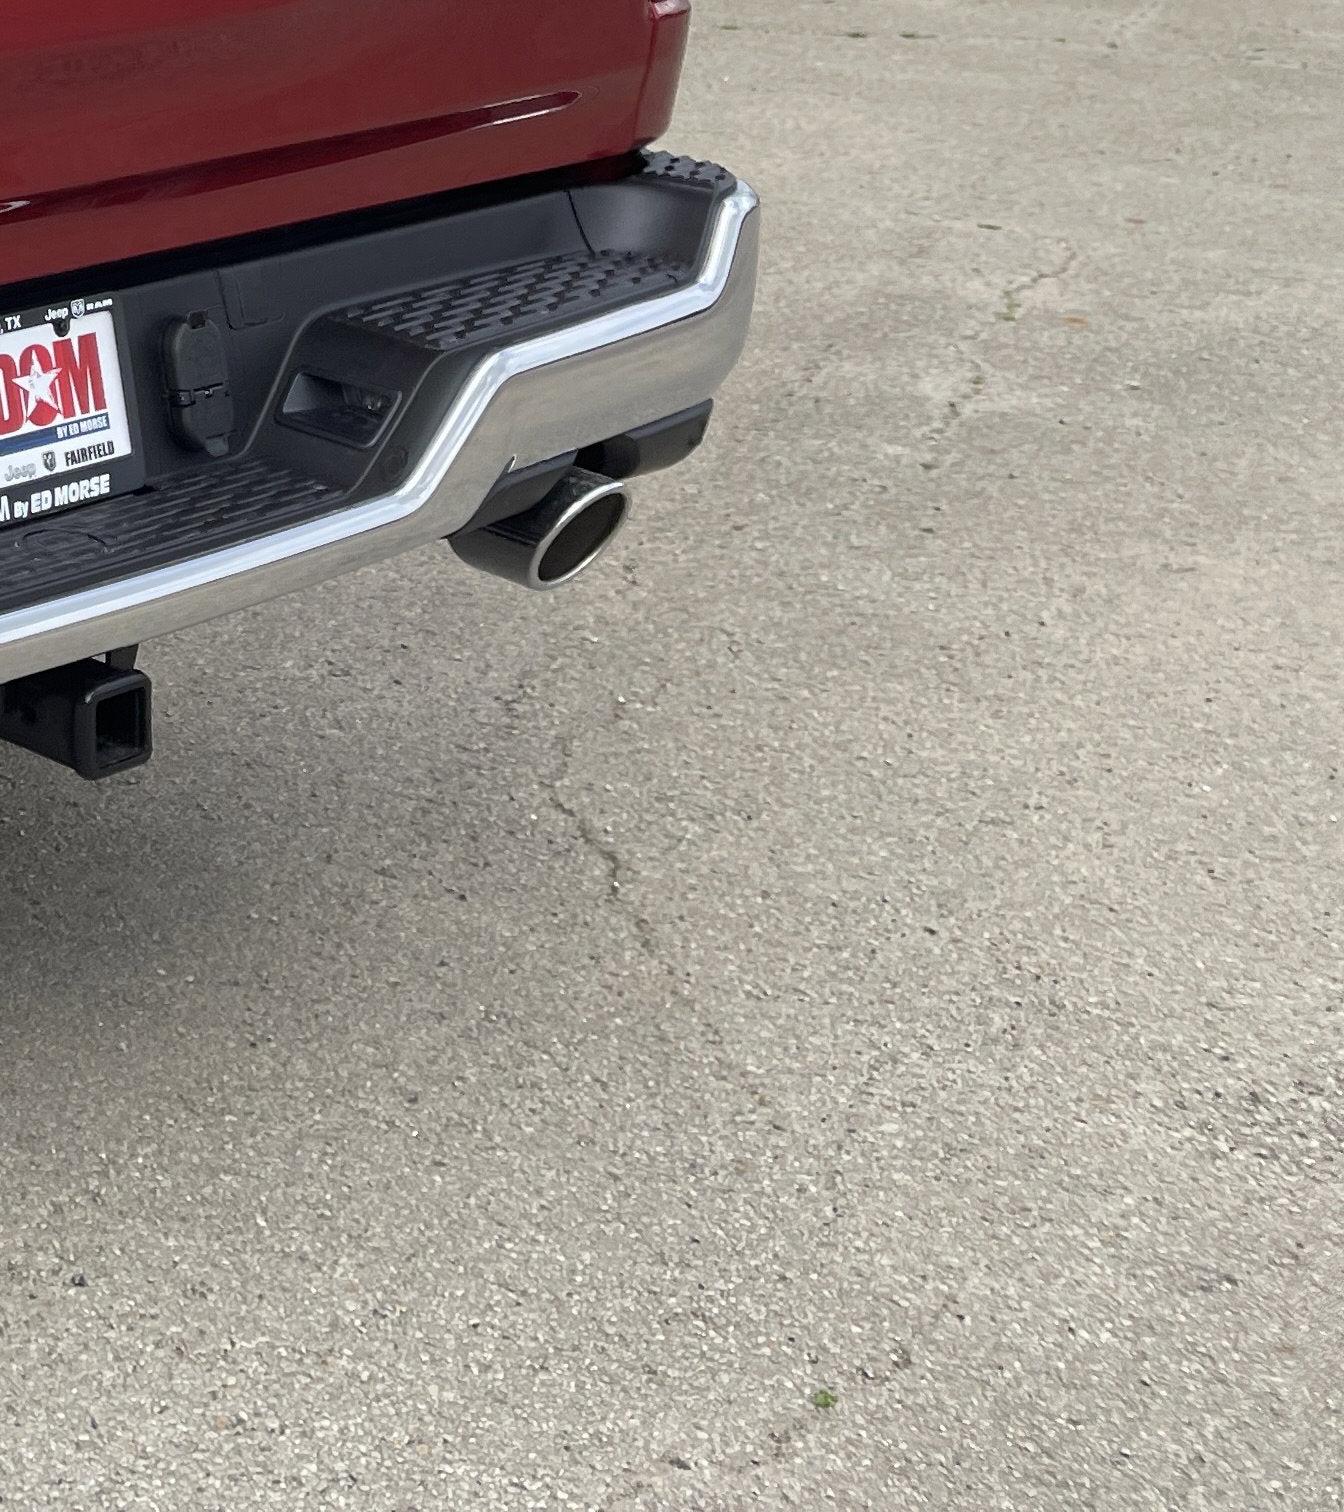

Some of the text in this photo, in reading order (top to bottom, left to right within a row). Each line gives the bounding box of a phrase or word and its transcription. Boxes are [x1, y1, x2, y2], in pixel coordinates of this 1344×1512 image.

[86, 298, 113, 310] RAM
[4, 315, 22, 330] TX
[44, 307, 69, 321] Jeep
[56, 415, 108, 439] BY ED MORSE
[64, 440, 115, 467] FAIRFIELD
[4, 463, 37, 482] Jeep
[30, 489, 53, 514] ED
[54, 474, 111, 506] MORSE
